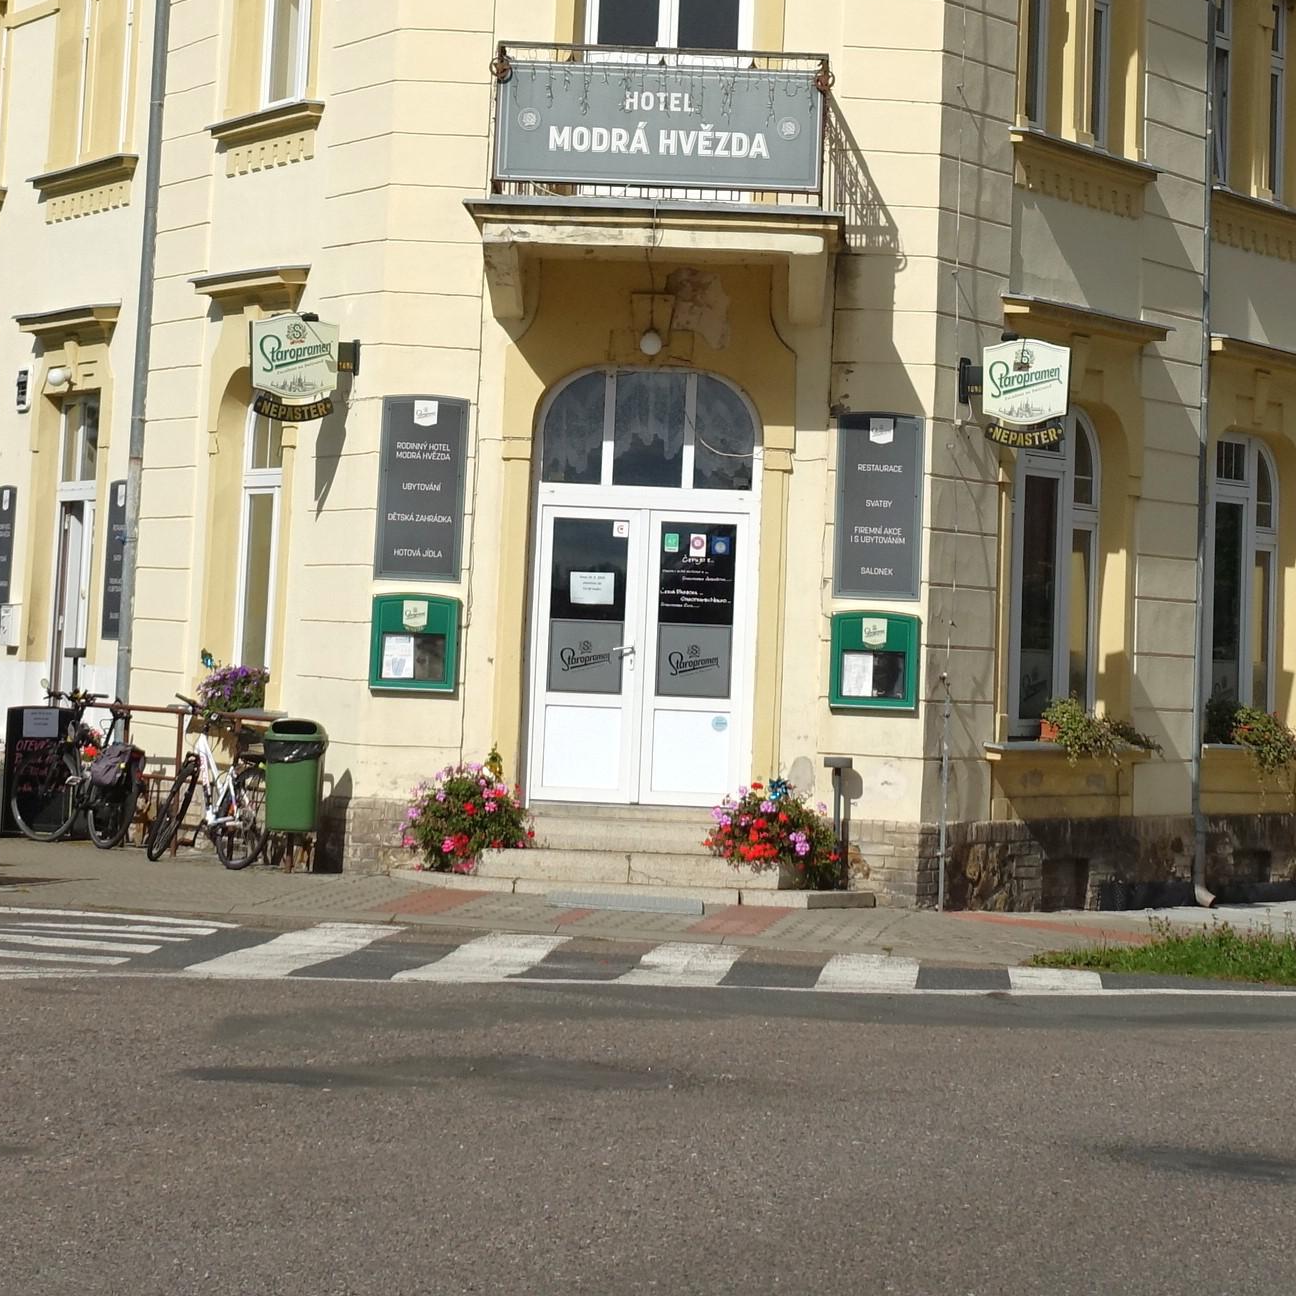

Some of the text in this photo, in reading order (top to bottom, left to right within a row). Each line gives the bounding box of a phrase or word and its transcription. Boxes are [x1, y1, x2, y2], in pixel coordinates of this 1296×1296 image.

[625, 91, 693, 113] HOTEL
[548, 121, 771, 160] MODRÁ HVĚZDA
[260, 335, 335, 373] Staropramen
[989, 361, 1062, 399] Staropramen
[261, 400, 327, 422] NEPASTER
[991, 426, 1058, 446] NEPASTER
[396, 440, 450, 452] RODINNÝ HOTEL
[396, 450, 450, 461] MODRÁ HVĚZDA
[857, 463, 903, 473] RESTAURACE
[402, 481, 442, 492] UBYTOVÁNÍ
[865, 499, 893, 509] SVATBY
[387, 511, 452, 524] DĚTSKÁ ZAHRÁDKA
[854, 524, 902, 536] FIREMNÍ AKCE
[860, 534, 906, 545] UBYTOVÁNÍM
[393, 547, 442, 558] HOTOVÁ JÍDLA
[860, 566, 893, 576] SALONEK
[560, 647, 612, 672] Staropramen
[668, 651, 720, 676] Staropramen
